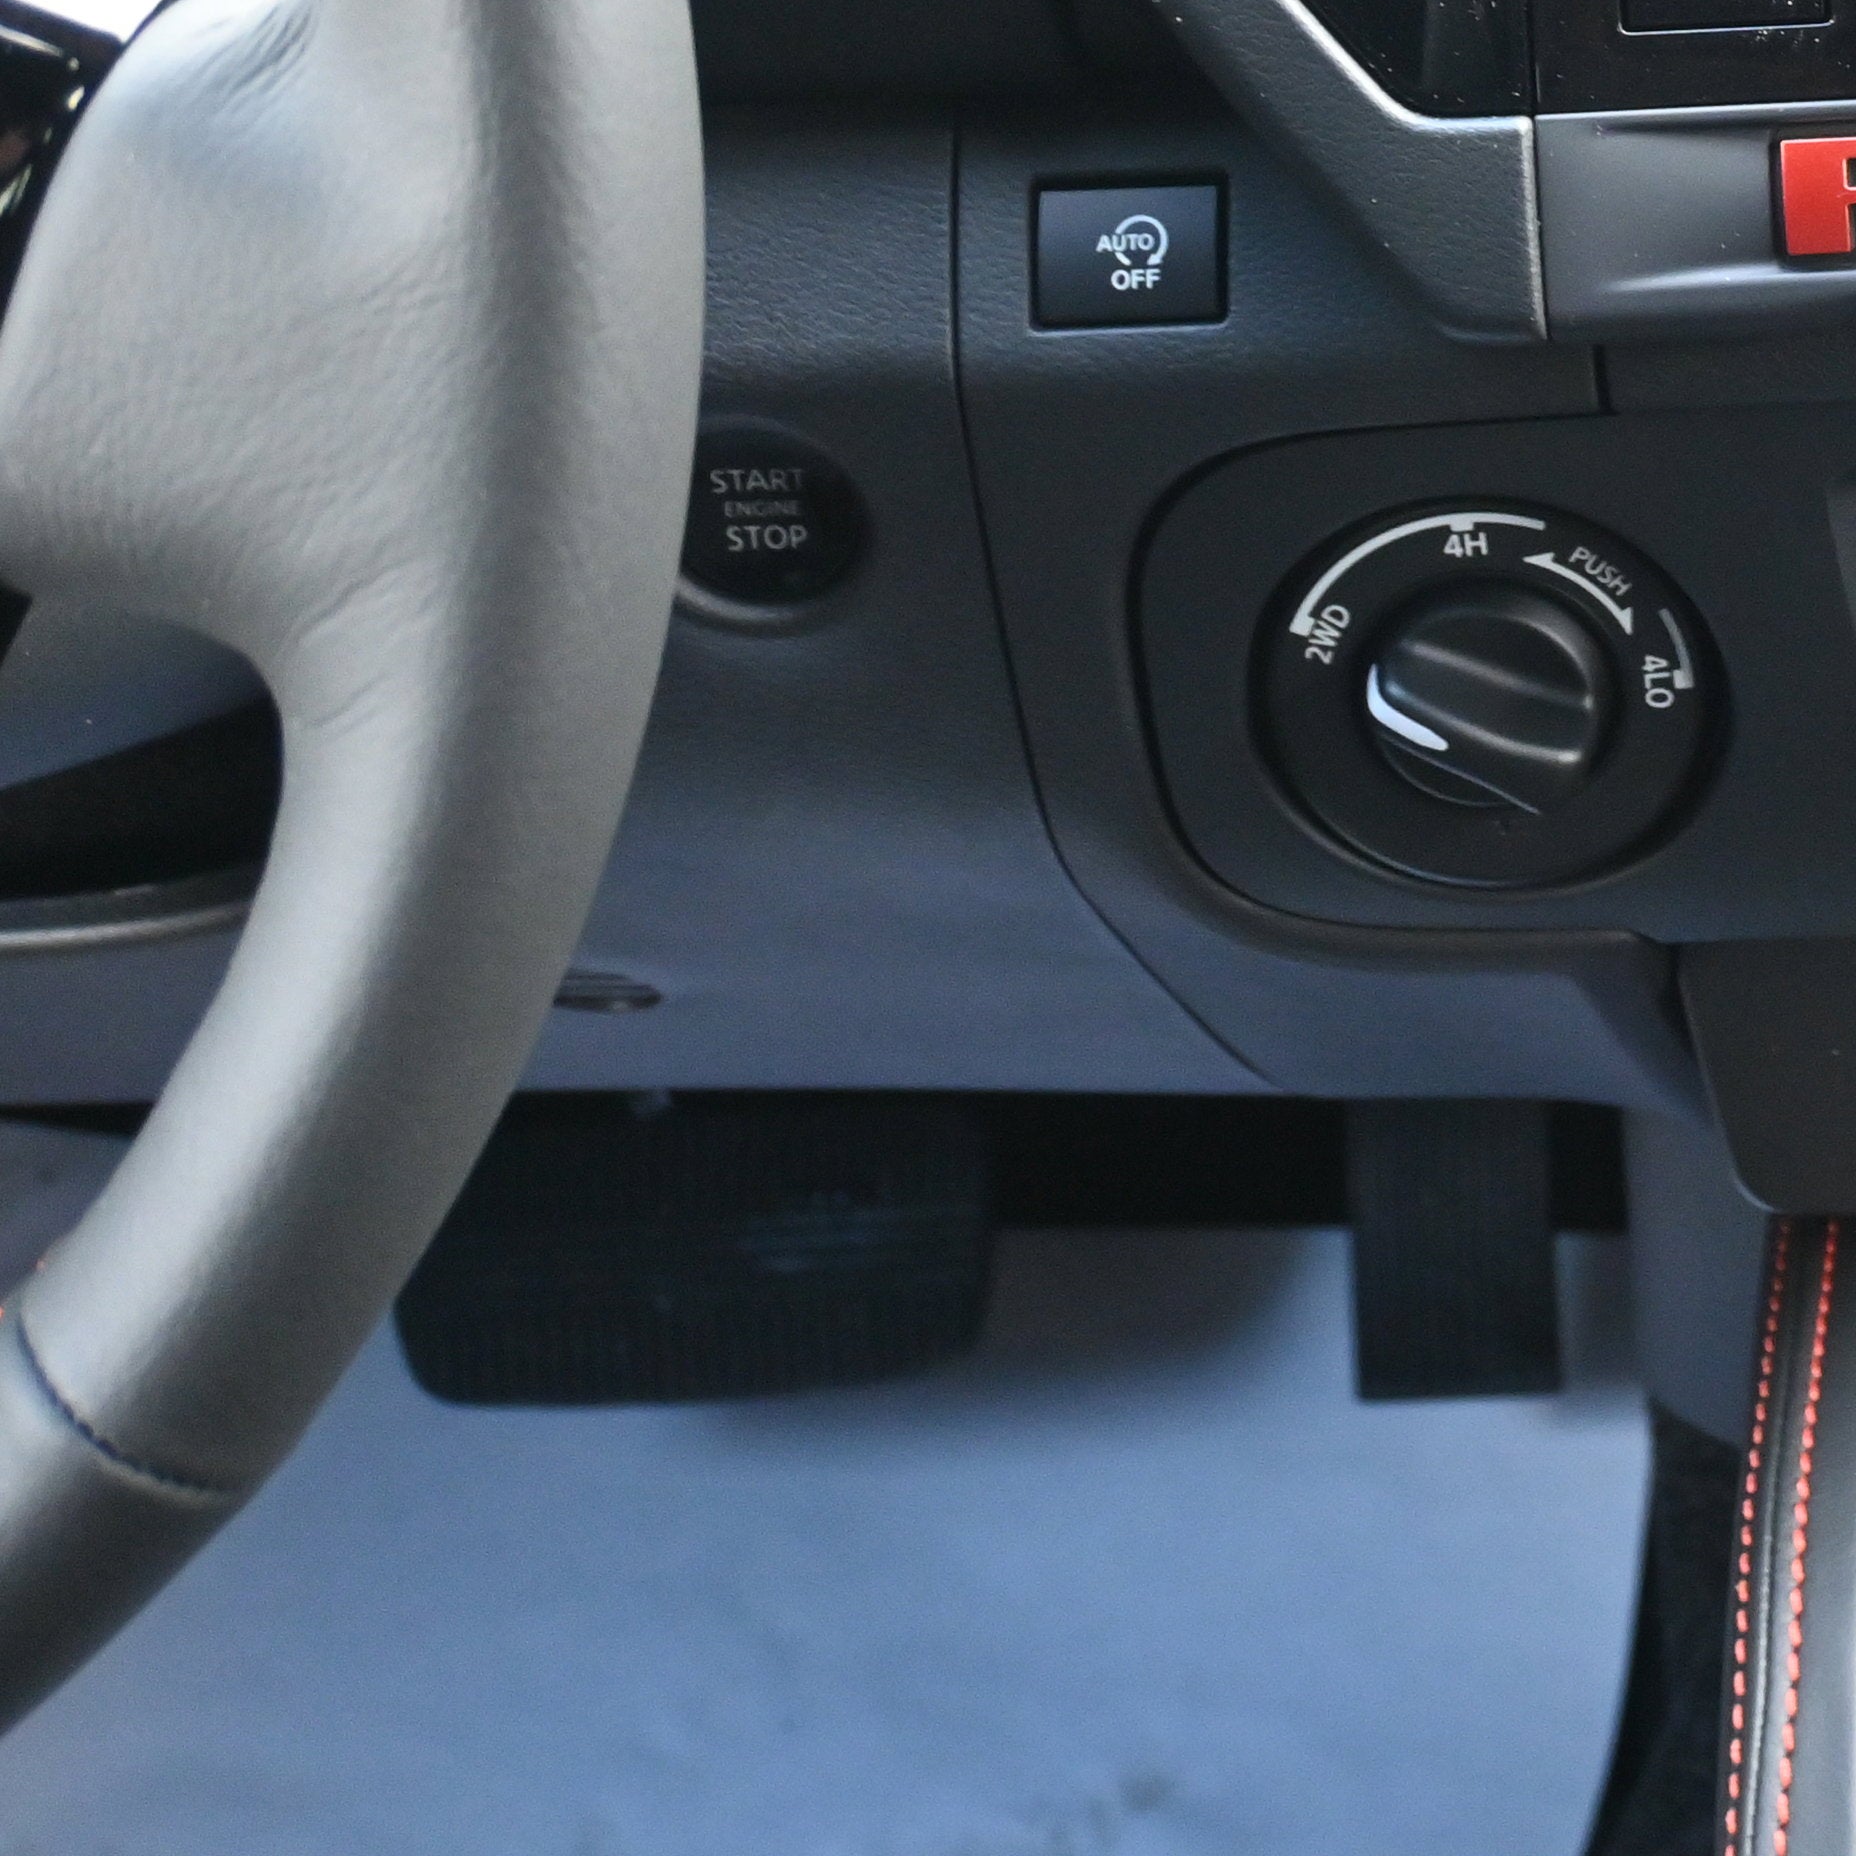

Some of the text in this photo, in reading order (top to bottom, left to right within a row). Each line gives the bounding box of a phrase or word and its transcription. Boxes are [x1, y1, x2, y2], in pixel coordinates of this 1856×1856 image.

[1095, 231, 1156, 253] AUTO
[1110, 268, 1161, 291] OFF
[708, 468, 803, 494] START
[726, 524, 807, 552] STOP
[1443, 532, 1488, 558] 4H
[1567, 546, 1630, 597] PUSH
[1303, 603, 1350, 664] 2WD
[1643, 655, 1677, 709] 4LO
